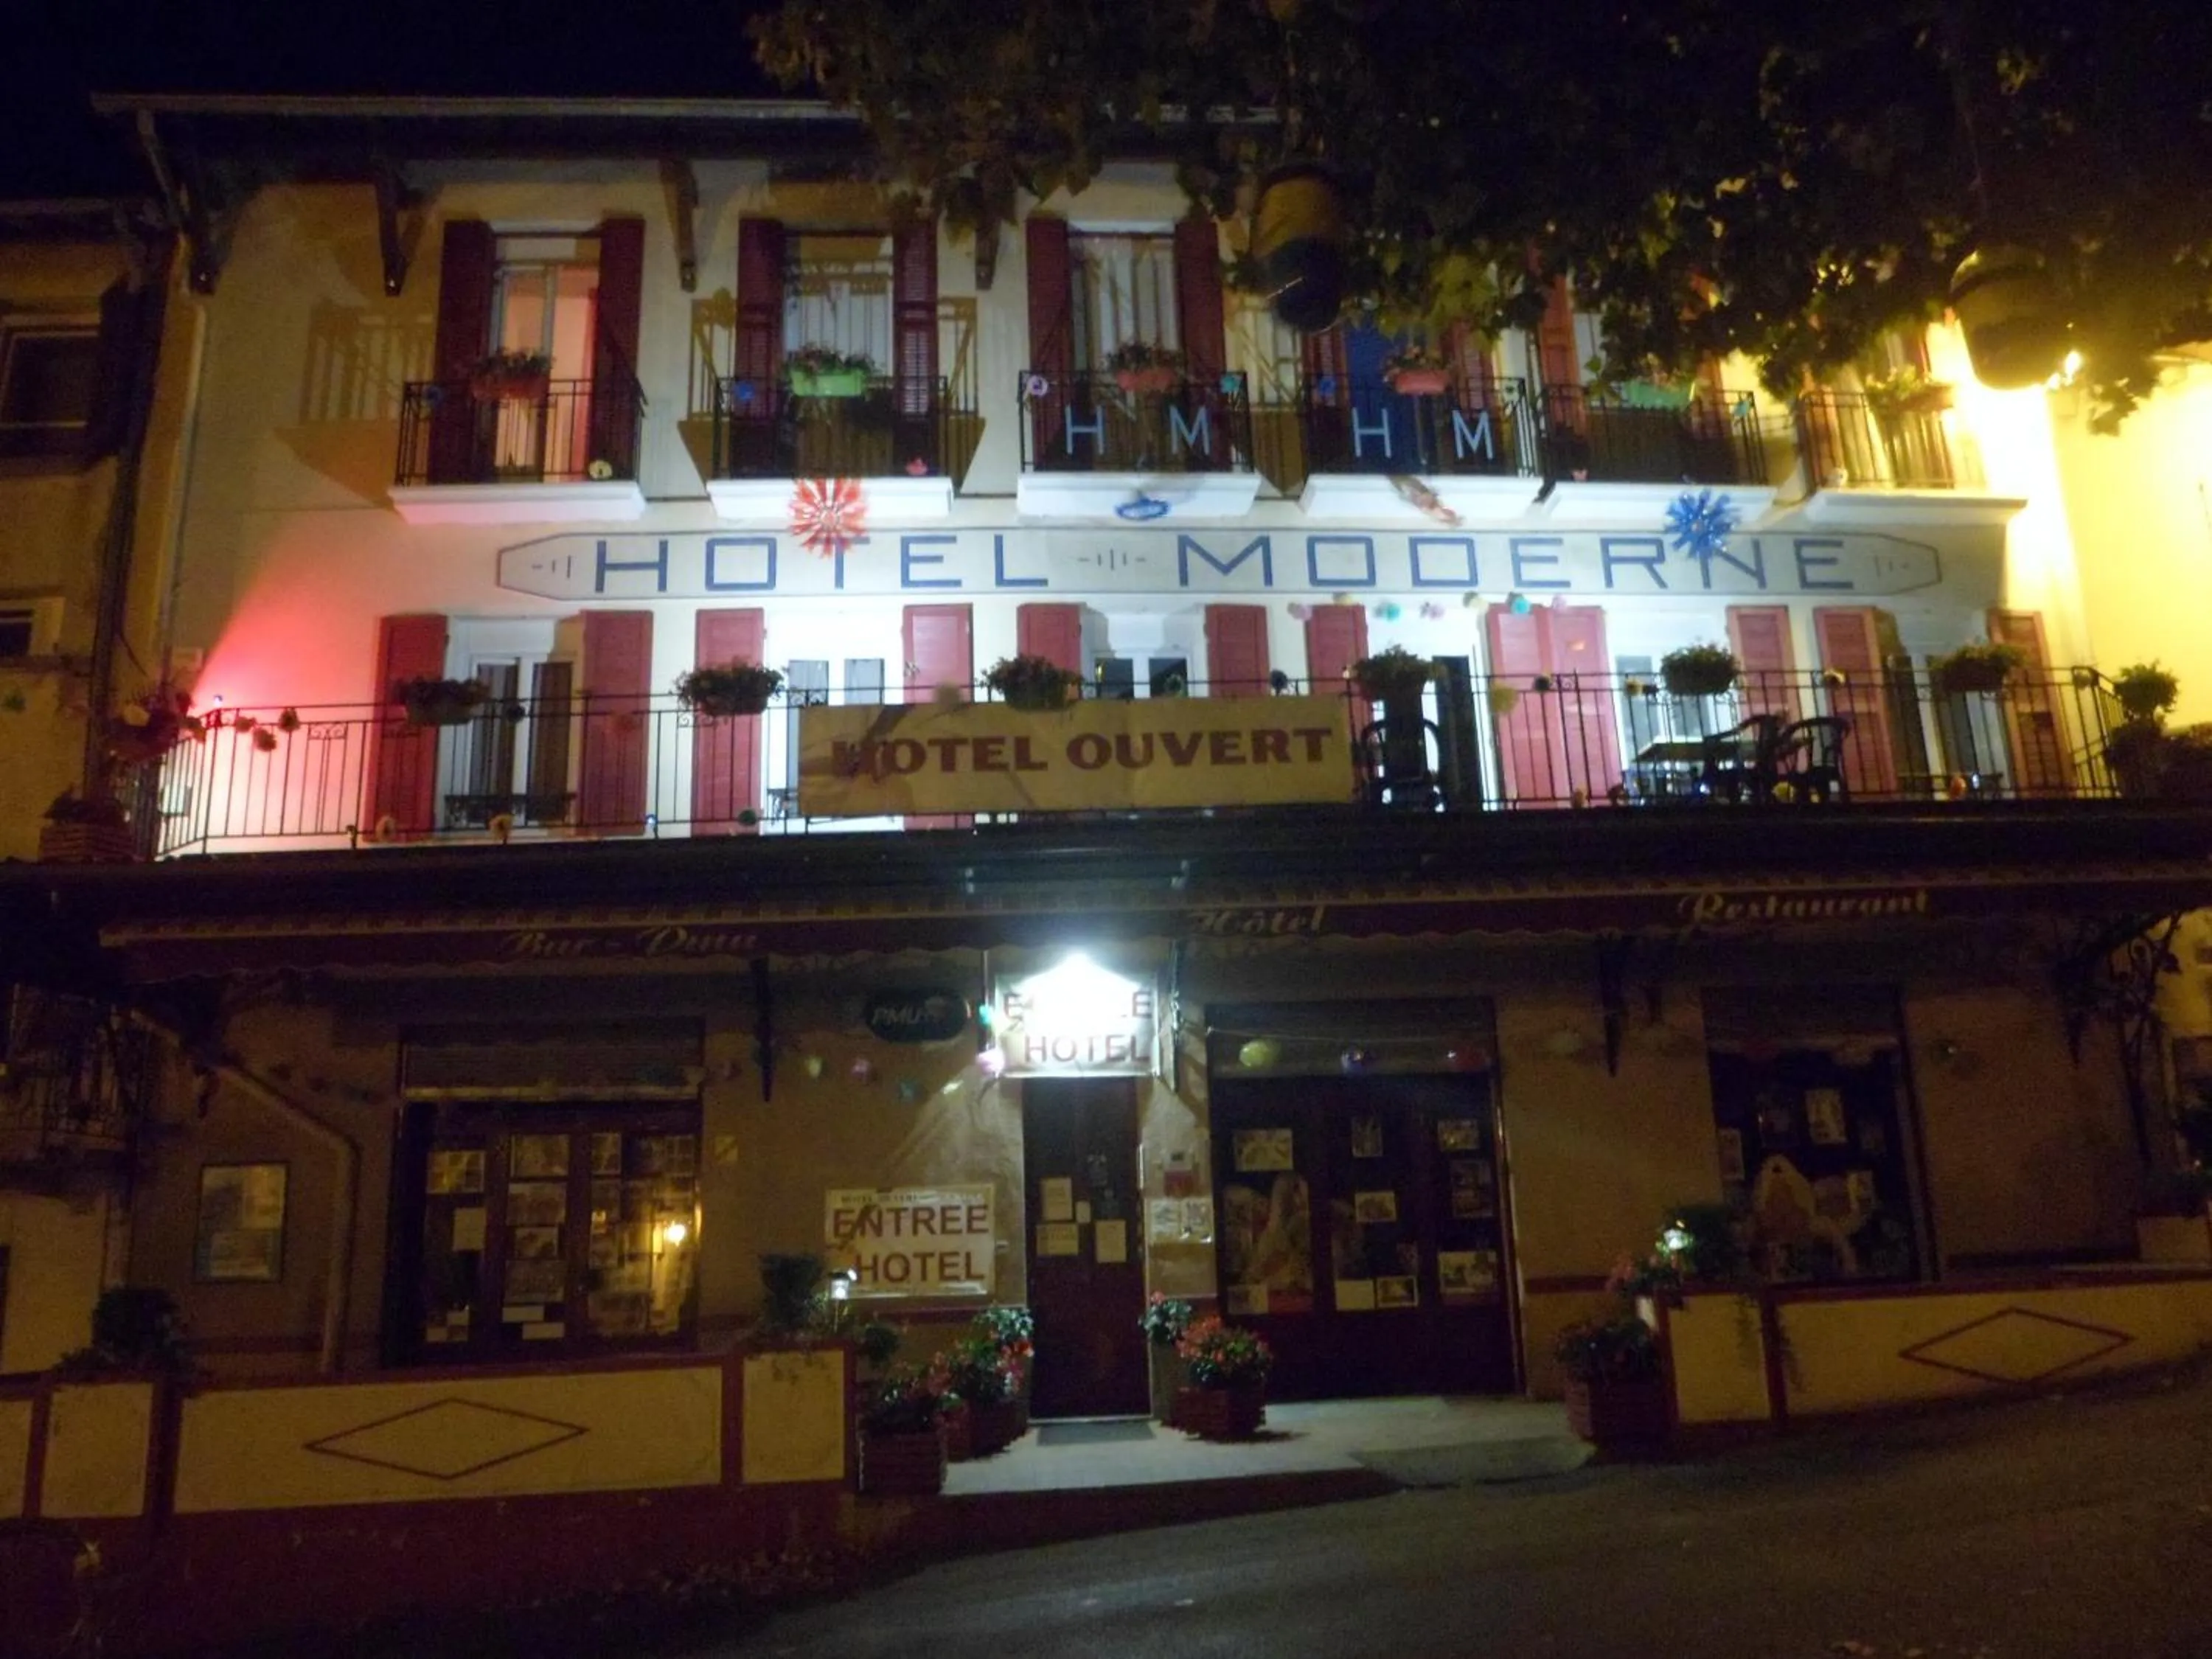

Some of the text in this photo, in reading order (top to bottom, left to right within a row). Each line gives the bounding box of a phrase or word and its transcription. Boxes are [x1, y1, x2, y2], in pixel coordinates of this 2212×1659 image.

[1064, 405, 1211, 456] H M
[1352, 408, 1494, 459] H M
[594, 532, 1856, 593] HOTEL MODERNE
[830, 726, 1334, 779] HOTEL OUVERT
[1677, 889, 1929, 919] Restaurant
[871, 1006, 922, 1026] PMU
[1024, 1034, 1151, 1063] HOTEL
[832, 1204, 990, 1239] ENTREE
[854, 1251, 985, 1284] HOTEL
